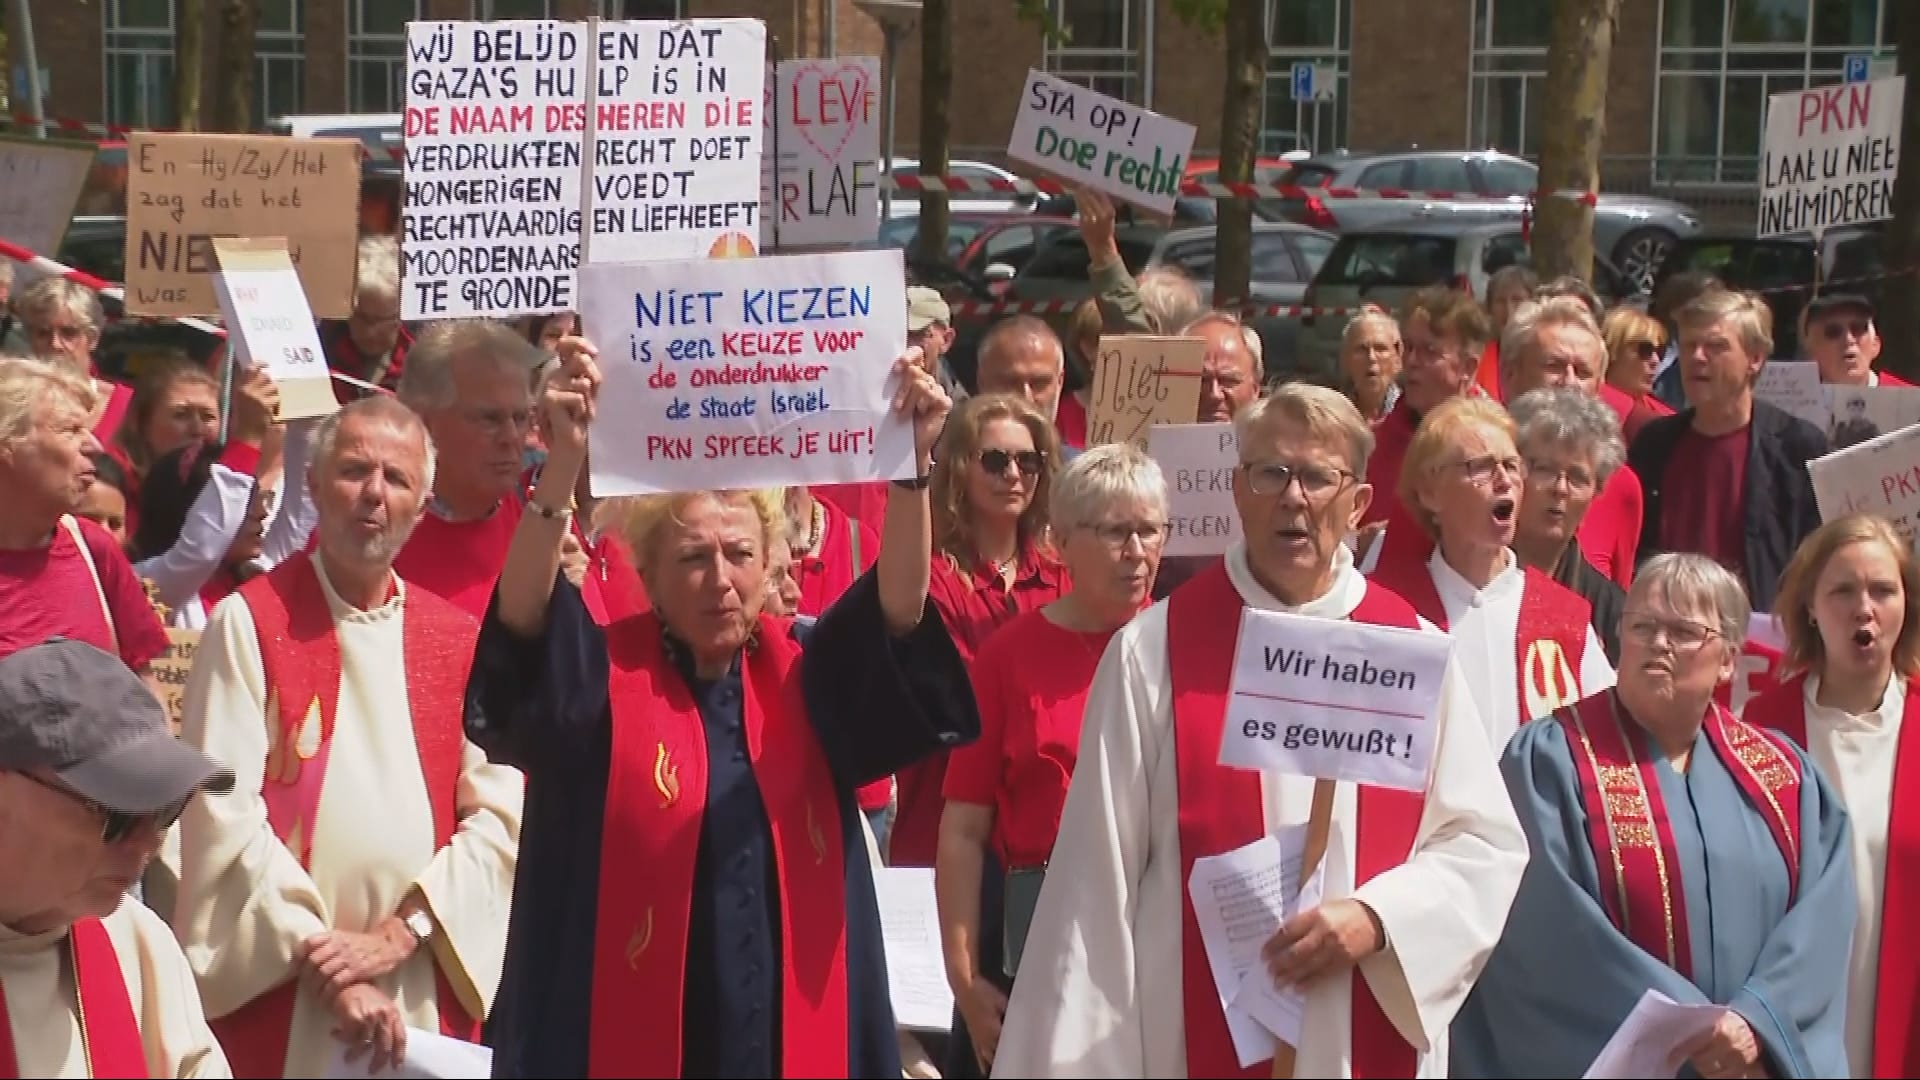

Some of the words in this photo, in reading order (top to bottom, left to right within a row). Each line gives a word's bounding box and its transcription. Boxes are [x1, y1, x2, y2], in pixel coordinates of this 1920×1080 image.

[599, 31, 639, 61] EN
[658, 29, 722, 59] DAT
[411, 66, 518, 100] GAZA'S
[1030, 81, 1075, 120] STA
[406, 105, 440, 138] DE
[450, 104, 533, 134] NAAM
[545, 103, 586, 133] DES
[597, 101, 685, 131] HEREN
[1798, 83, 1872, 137] PKN
[139, 143, 176, 175] En
[405, 140, 580, 172] VERDRUKTEN
[595, 137, 676, 166] RECHT
[690, 135, 750, 161] DOET
[1035, 125, 1097, 170] Doe
[1104, 145, 1181, 197] recht
[594, 170, 695, 201] VOEDT
[139, 190, 185, 223] zag
[201, 189, 243, 209] dat
[261, 186, 302, 208] het
[593, 207, 625, 234] EN
[402, 244, 581, 277] MOORDENAARS
[415, 280, 448, 314] TE
[461, 275, 570, 310] GRONDE
[744, 286, 871, 324] KIEZEN
[630, 334, 652, 362] is
[665, 337, 715, 360] een
[647, 361, 676, 388] de
[690, 362, 829, 387] onderdrukker
[665, 397, 690, 420] de
[647, 435, 692, 460] PKN
[1264, 645, 1316, 677] Wir
[1322, 654, 1416, 690] haben
[1242, 719, 1277, 740] es
[1283, 723, 1397, 757] gewußt
